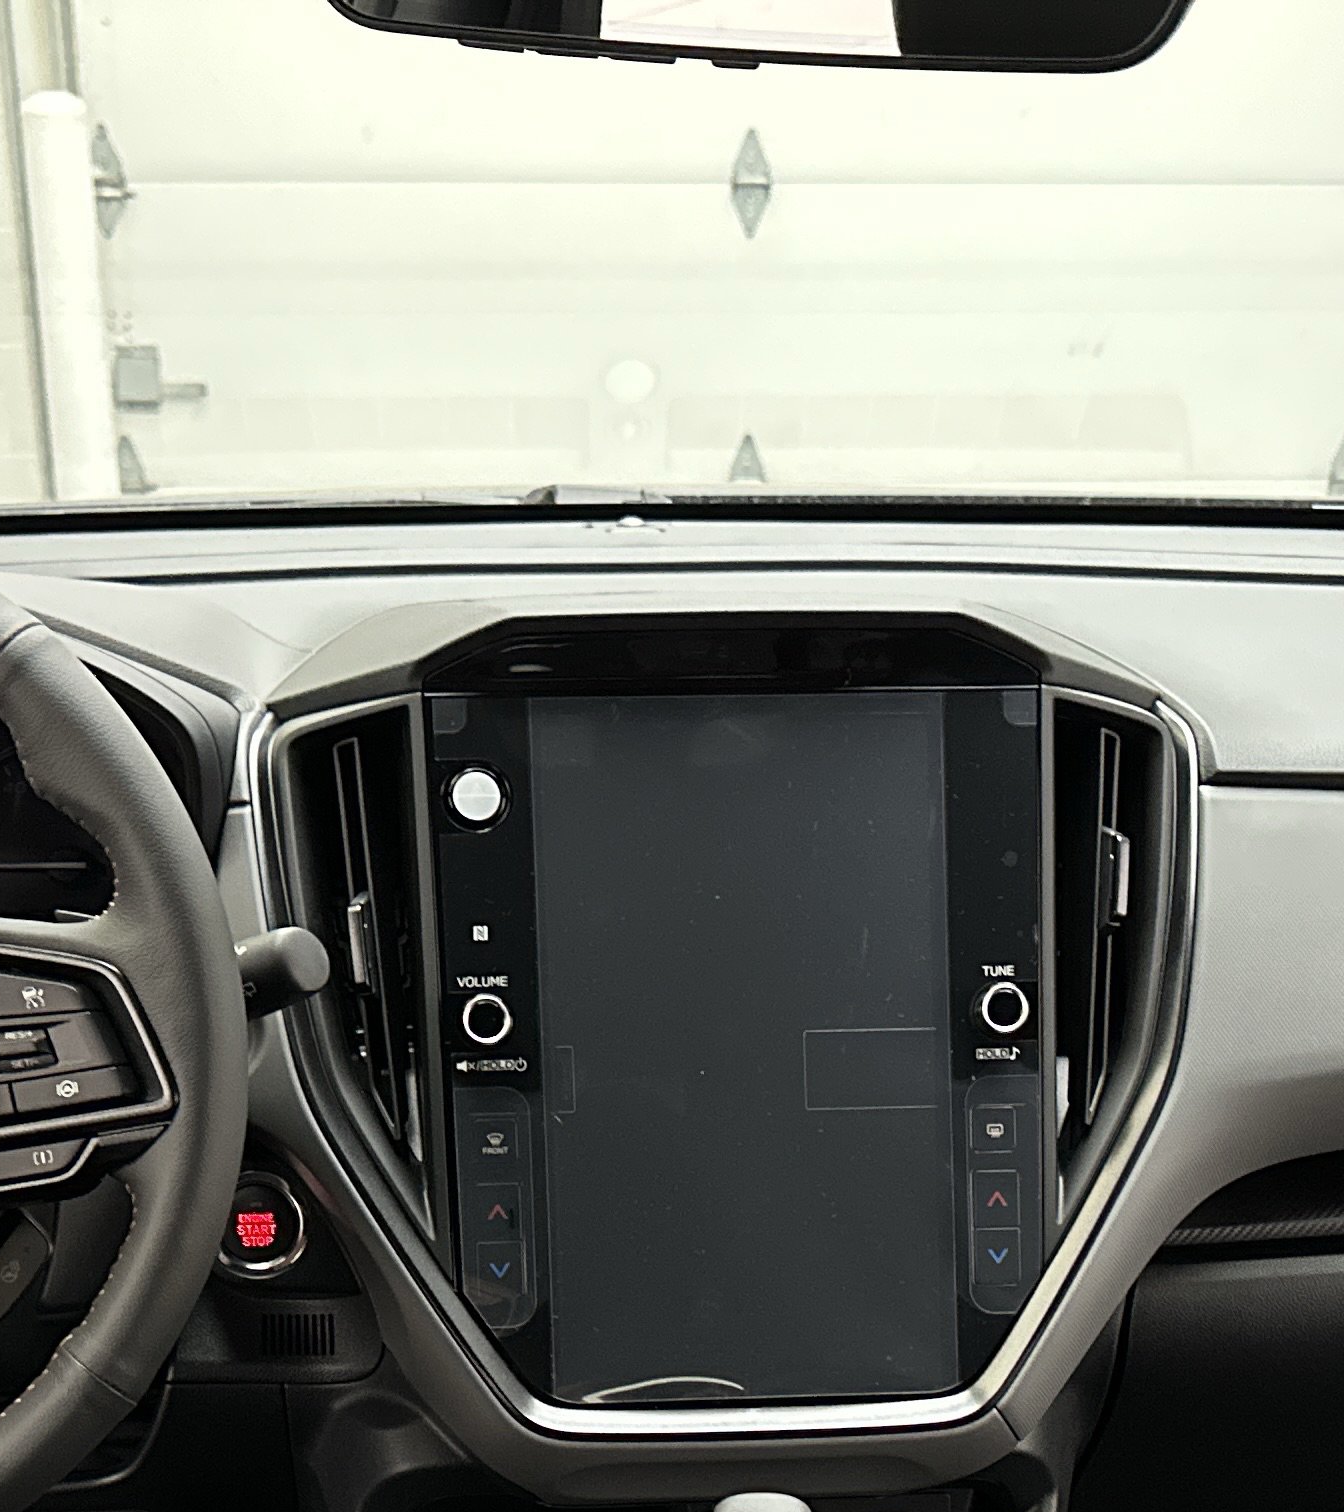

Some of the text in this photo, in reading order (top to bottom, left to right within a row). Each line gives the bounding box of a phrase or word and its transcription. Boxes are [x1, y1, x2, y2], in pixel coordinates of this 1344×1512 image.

[981, 965, 1015, 976] TUNE
[456, 976, 509, 988] VOLUME
[977, 1048, 1009, 1059] HOLD
[481, 1059, 515, 1071] HOLD
[238, 1213, 274, 1223] ENGINE
[237, 1225, 276, 1235] START
[242, 1236, 274, 1246] STOP
